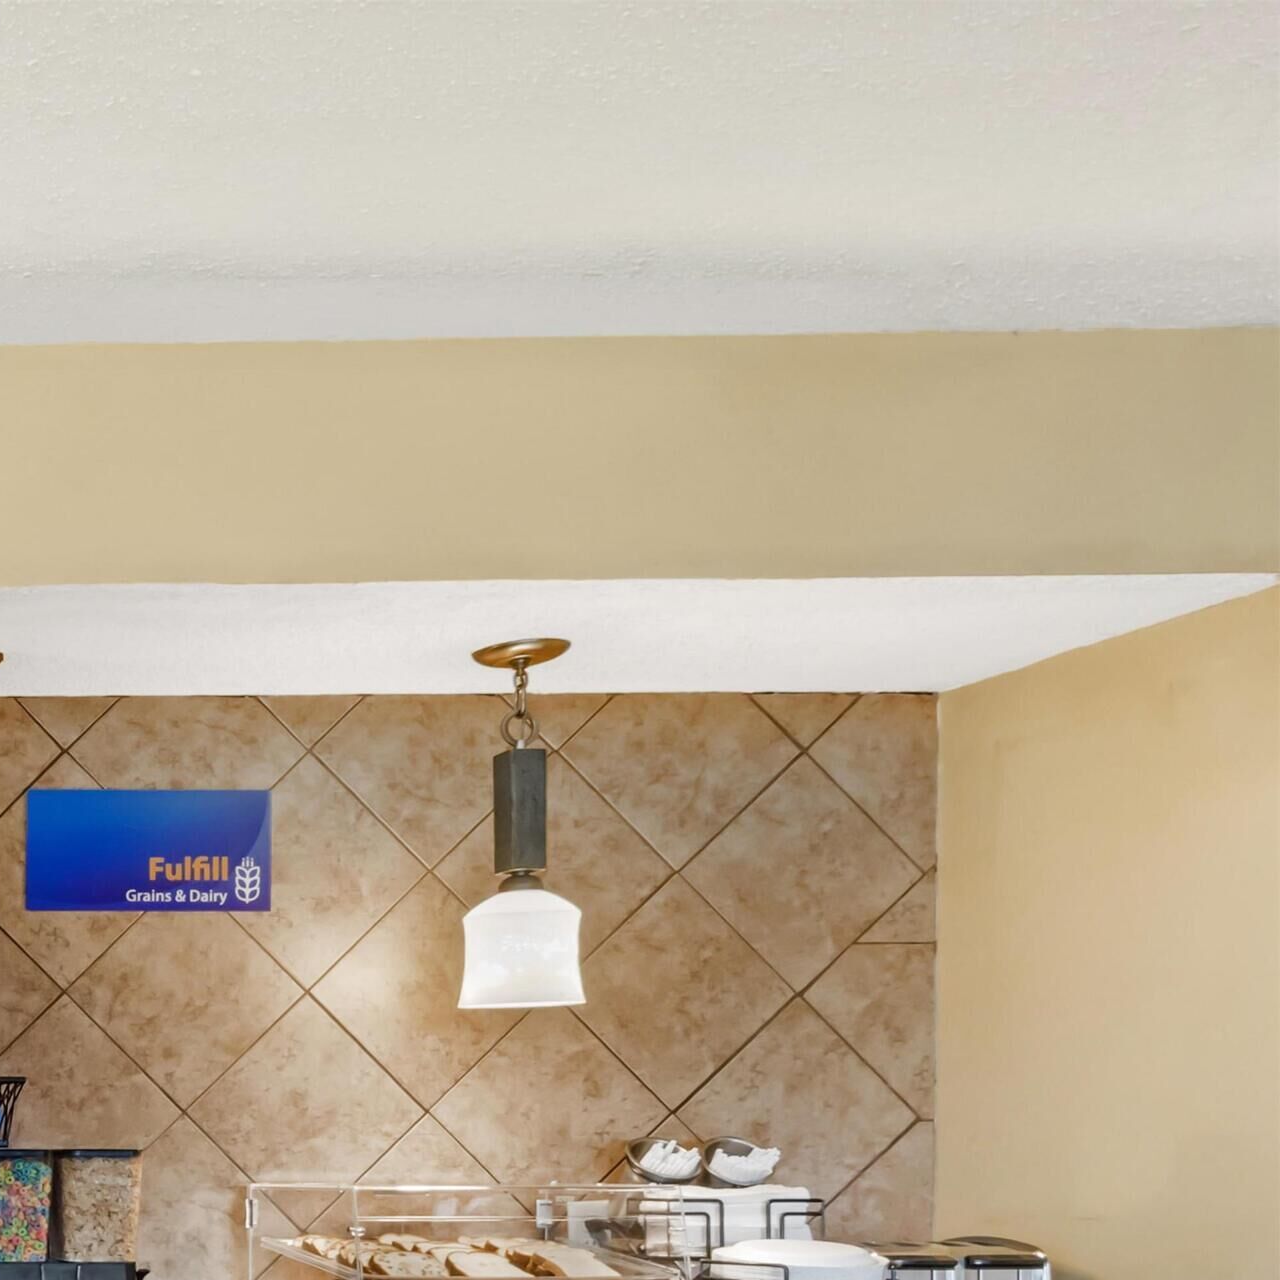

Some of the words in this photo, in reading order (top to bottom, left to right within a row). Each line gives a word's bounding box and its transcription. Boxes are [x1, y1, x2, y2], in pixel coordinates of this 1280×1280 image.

[148, 856, 228, 881] Fulfill
[125, 888, 171, 903] Grains
[175, 889, 186, 903] &
[190, 889, 228, 905] Dairy
